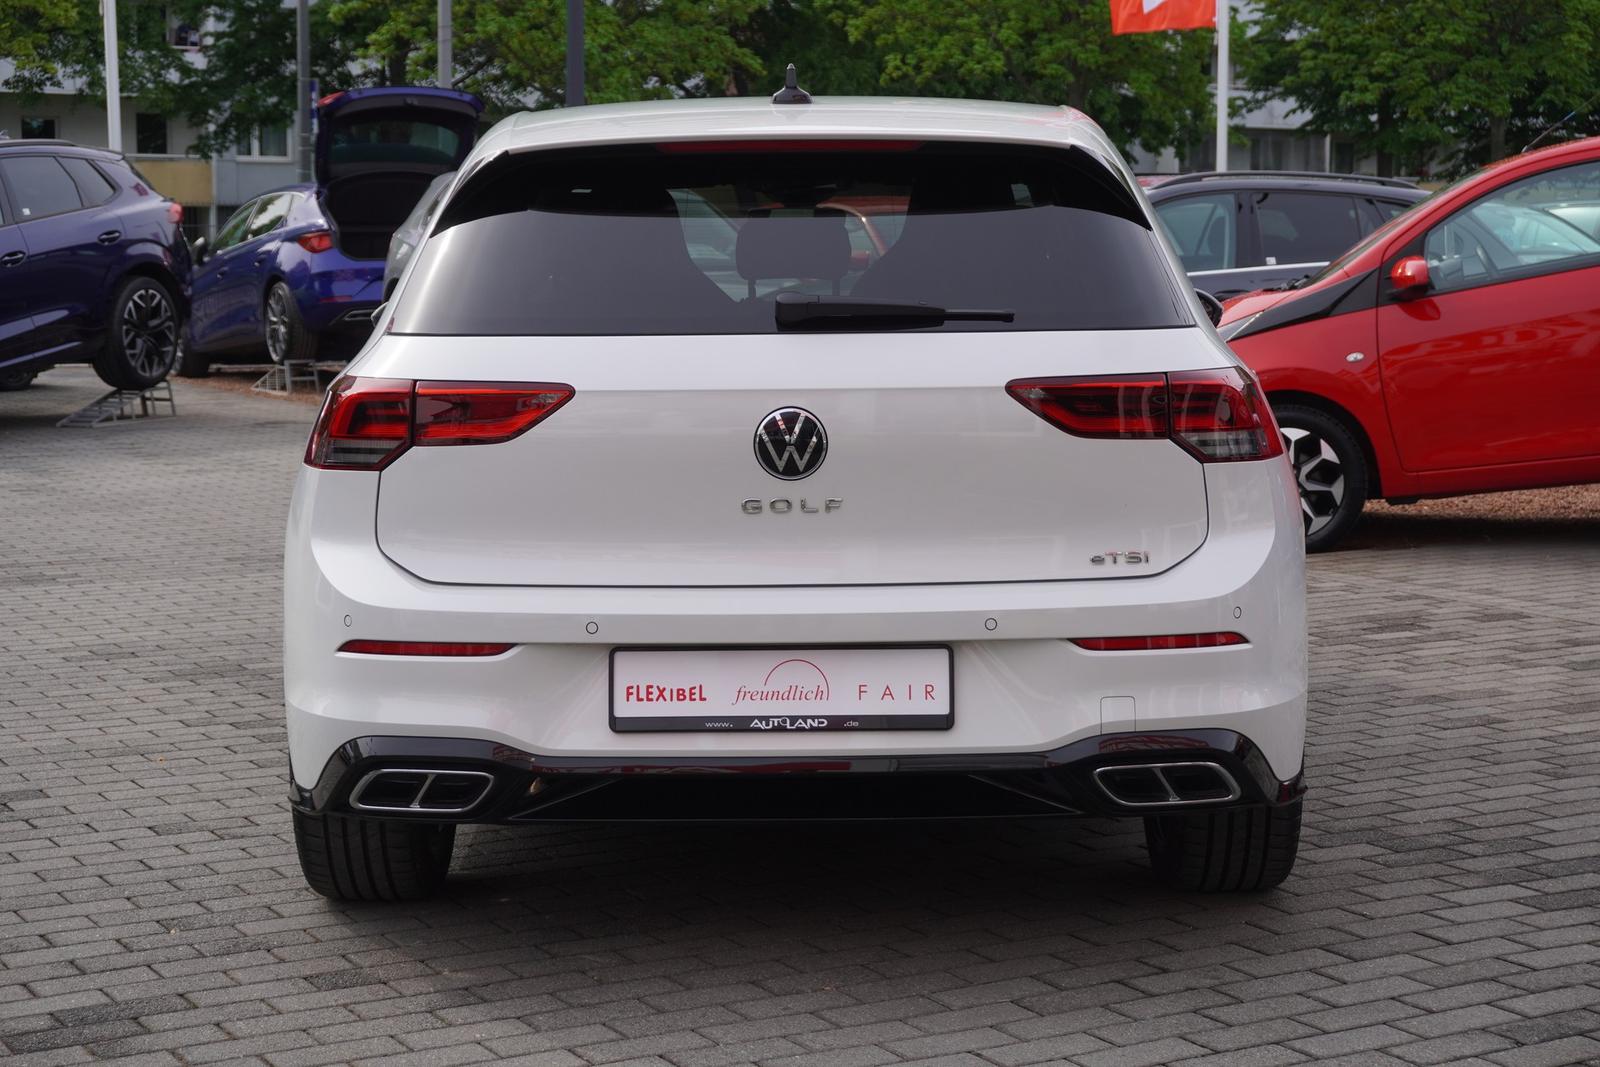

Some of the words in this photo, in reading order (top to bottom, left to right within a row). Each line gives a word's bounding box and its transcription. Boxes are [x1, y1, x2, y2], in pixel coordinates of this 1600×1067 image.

[741, 497, 844, 514] GOLF
[625, 684, 707, 703] FLEXIBEL
[731, 684, 824, 706] freundlich
[858, 684, 936, 701] FAIR
